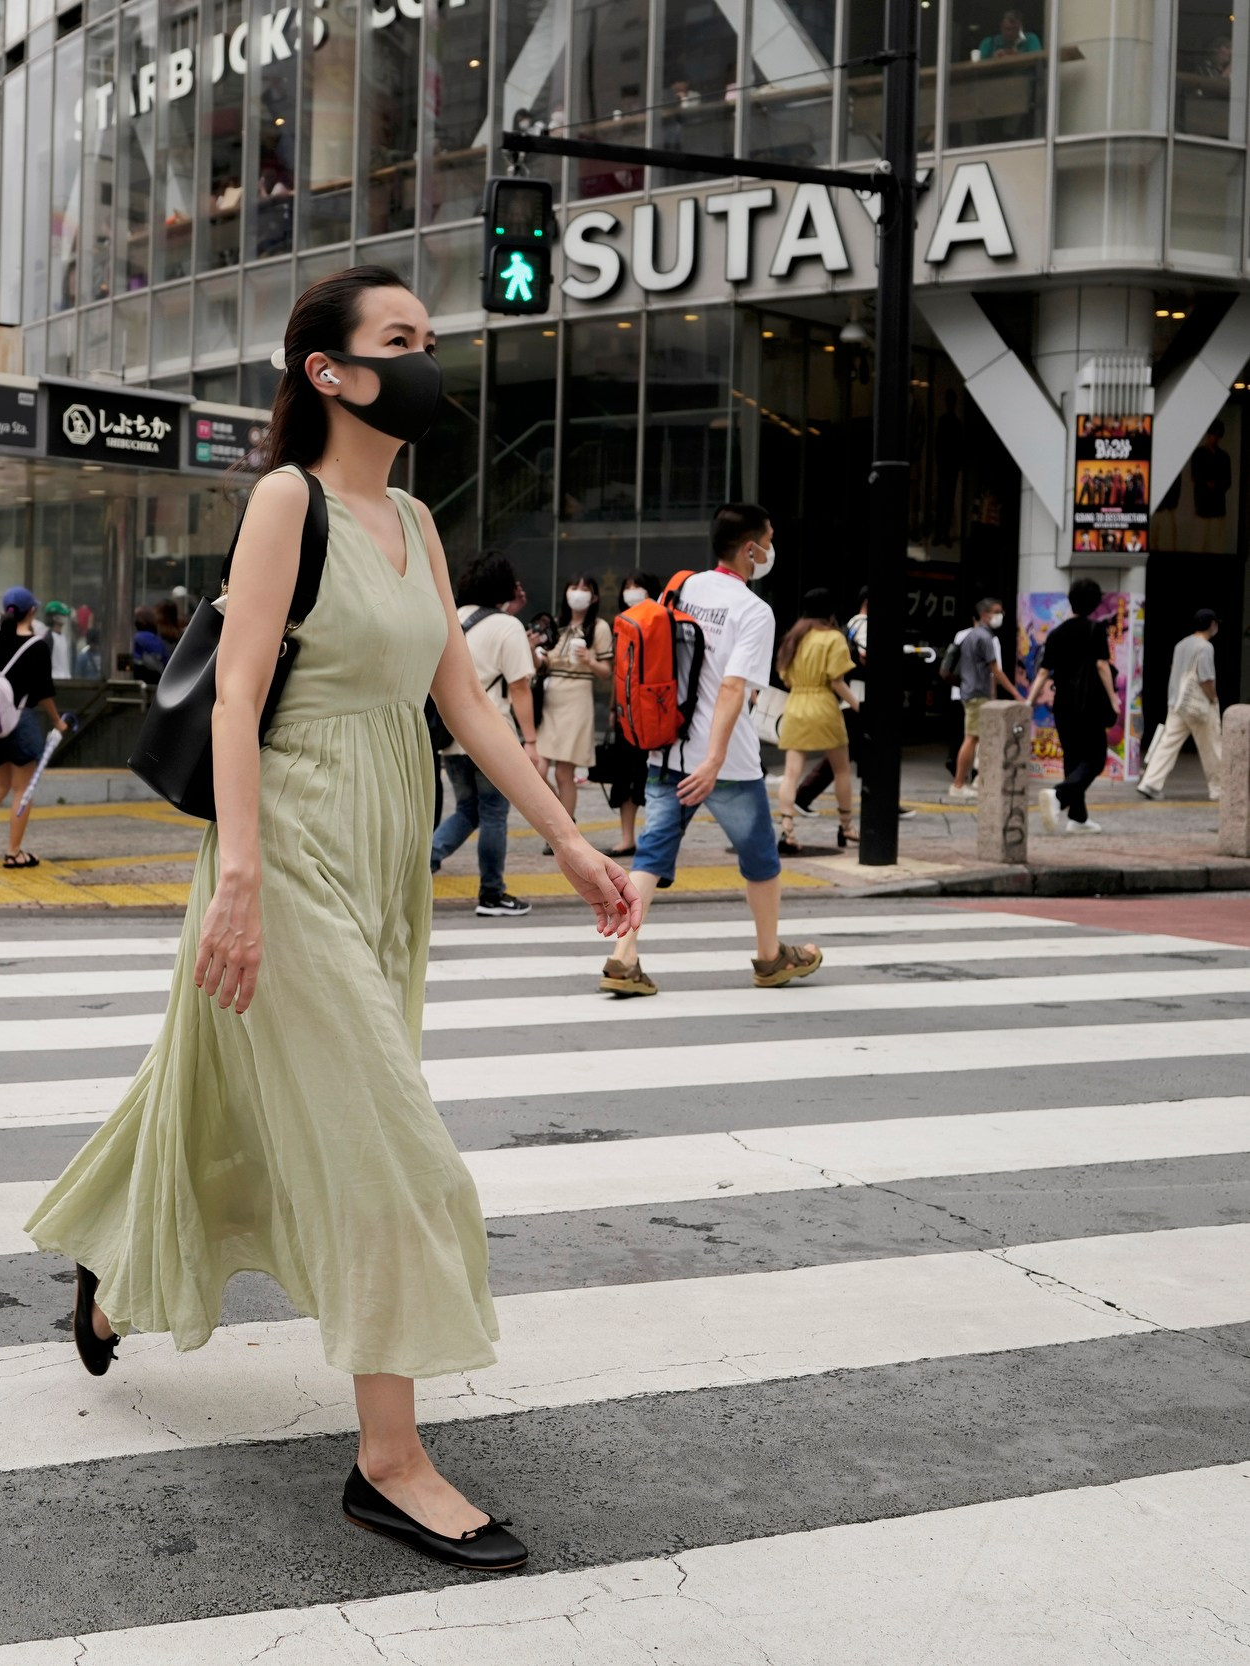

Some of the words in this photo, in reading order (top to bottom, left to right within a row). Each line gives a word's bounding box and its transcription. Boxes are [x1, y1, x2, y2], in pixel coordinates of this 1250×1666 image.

[75, 0, 326, 141] TRBCKS
[11, 421, 29, 435] Sta.
[99, 409, 171, 440] しぶちか
